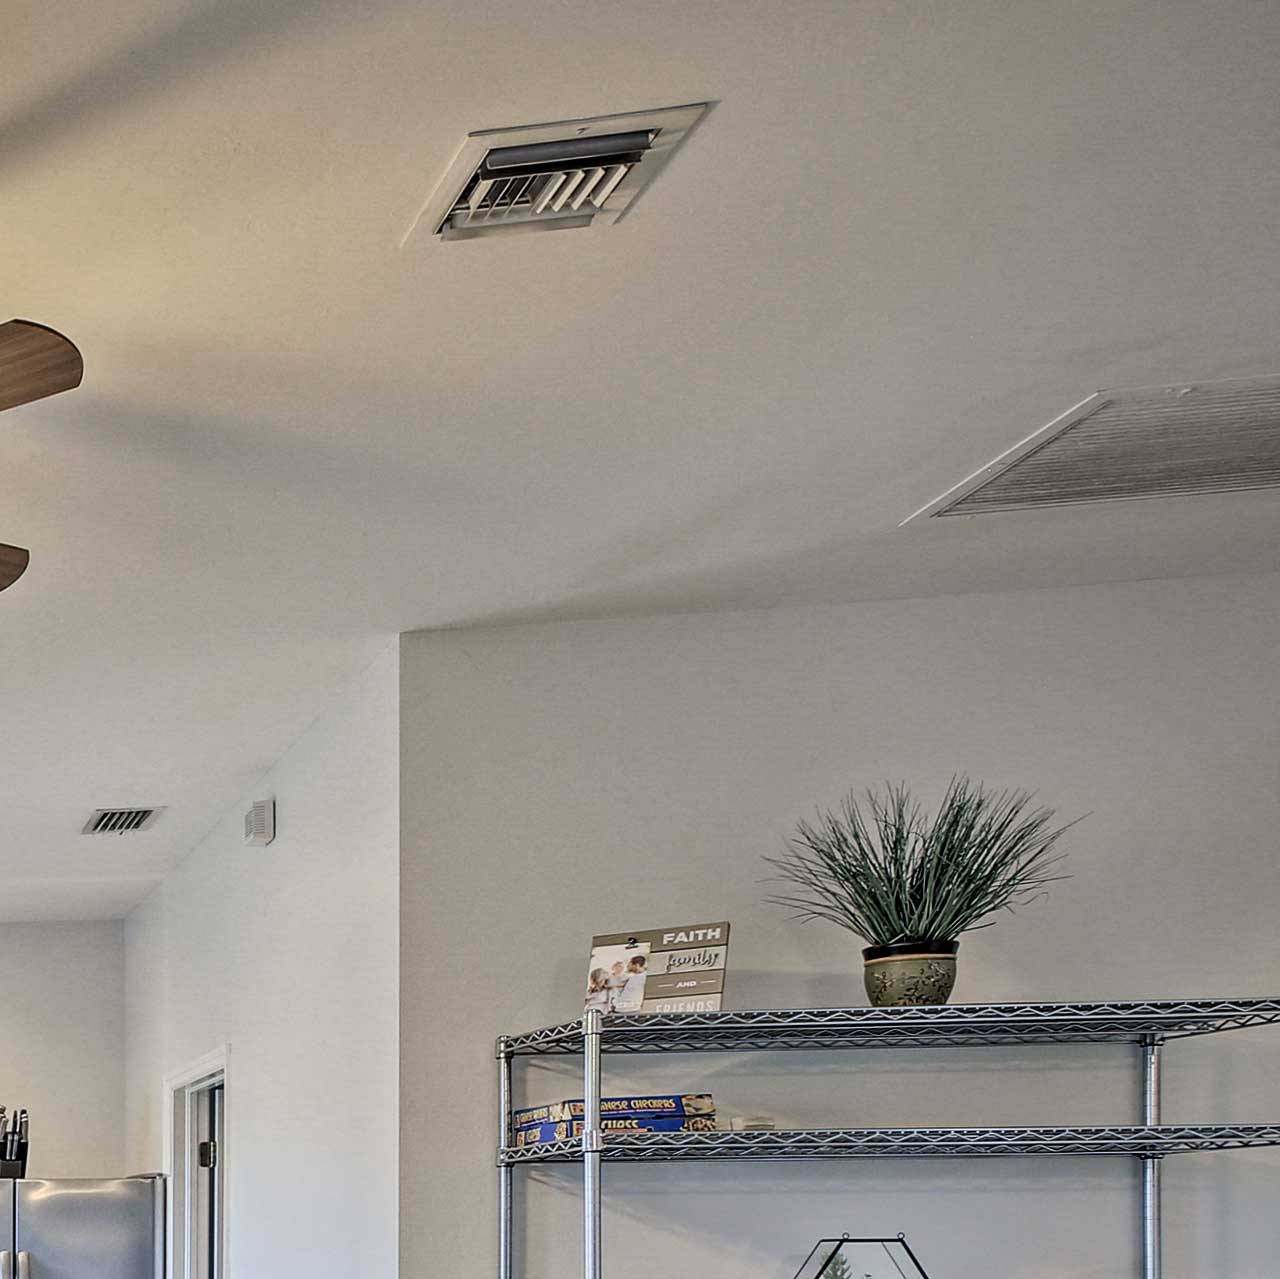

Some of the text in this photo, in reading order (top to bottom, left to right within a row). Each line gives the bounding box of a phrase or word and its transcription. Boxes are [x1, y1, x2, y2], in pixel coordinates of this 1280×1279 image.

[662, 928, 722, 945] FAITH
[666, 949, 719, 973] family
[675, 980, 698, 989] AND
